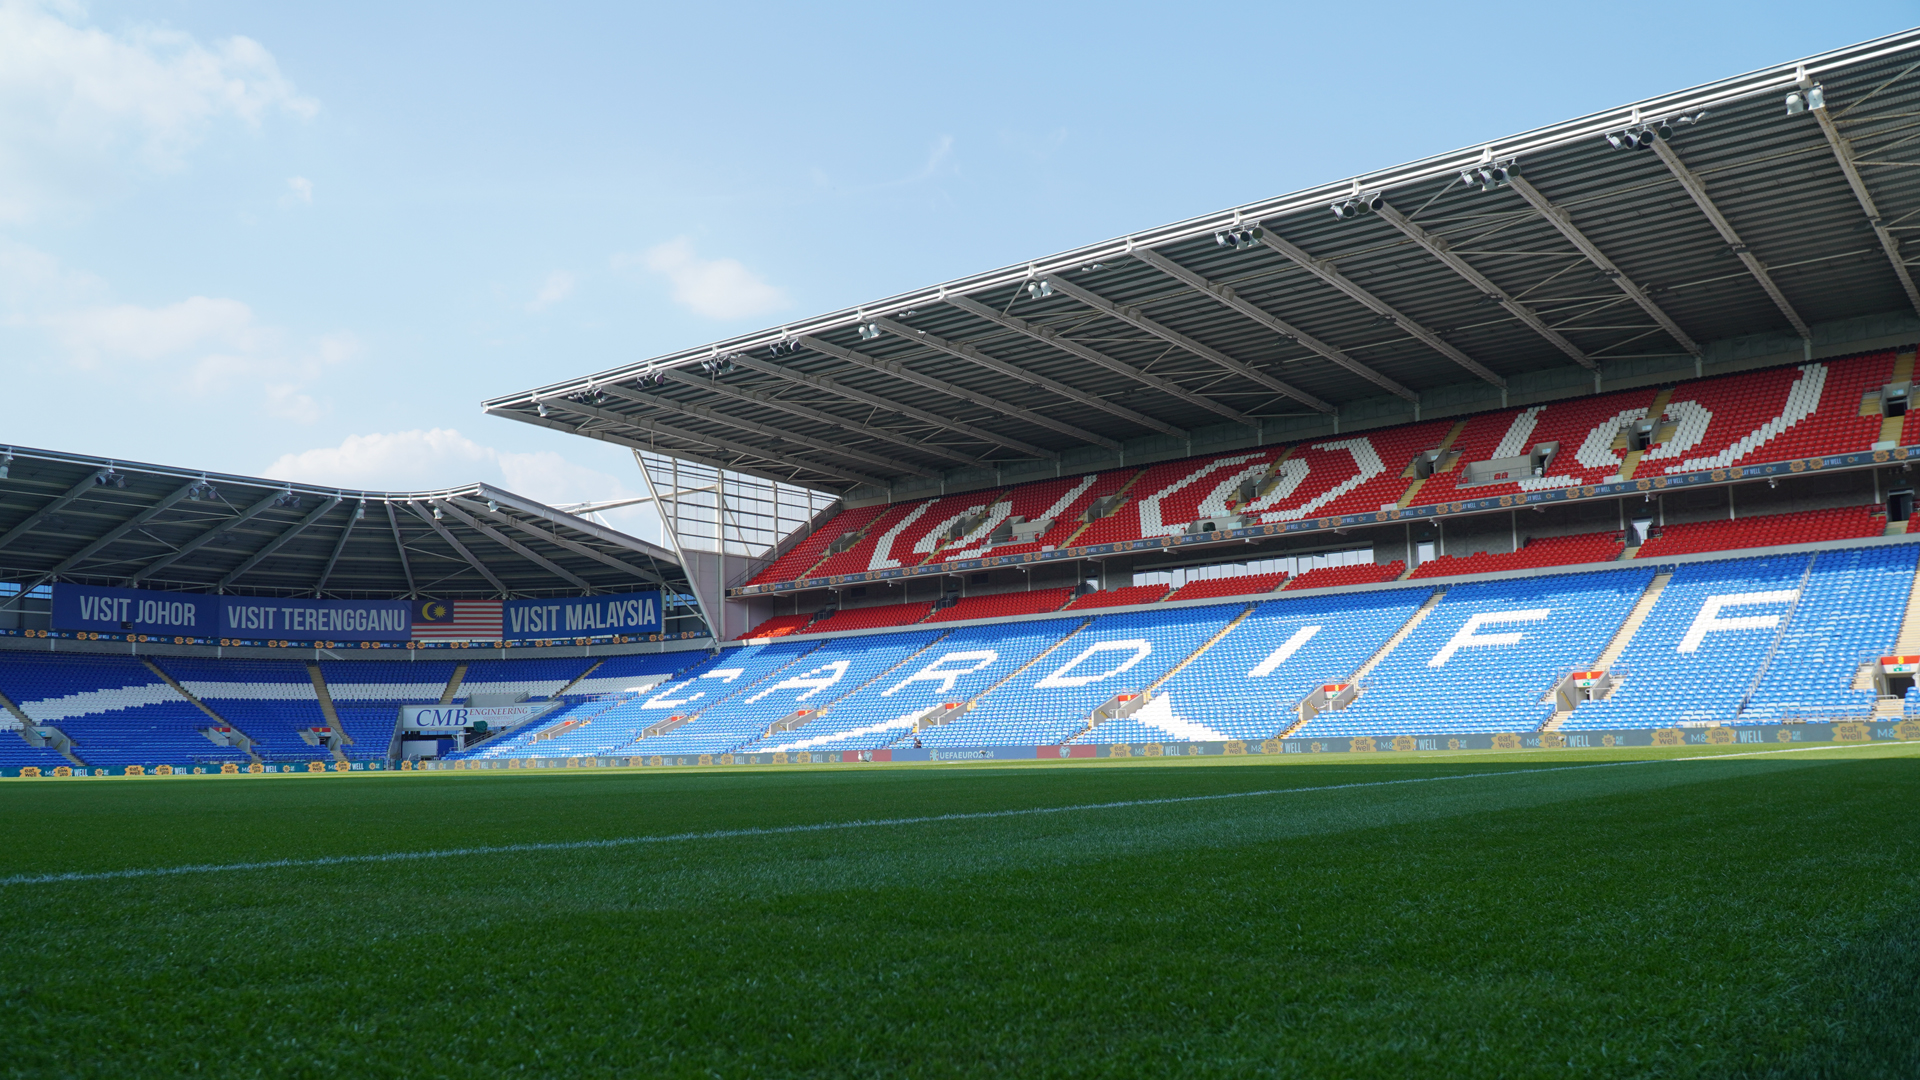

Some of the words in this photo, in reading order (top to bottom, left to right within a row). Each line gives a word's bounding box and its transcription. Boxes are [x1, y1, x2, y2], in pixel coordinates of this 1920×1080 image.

[80, 596, 131, 622] VISIT
[136, 600, 195, 626] JOHOR
[510, 606, 560, 632] VISIT
[566, 598, 656, 630] MALAYSIA
[228, 606, 277, 629] VISIT
[281, 608, 405, 631] TERENGGANU
[416, 709, 468, 726] CMB
[469, 707, 528, 716] ENGINEERING
[1840, 724, 1858, 733] eat
[1569, 735, 1590, 747] WELL
[1659, 734, 1677, 745] well
[1739, 730, 1764, 743] WELL
[1841, 731, 1862, 740] well
[1285, 742, 1302, 753] WELL
[1419, 739, 1437, 750] WELL
[1498, 740, 1514, 748] well
[1165, 746, 1180, 756] WELL
[813, 754, 823, 763] WELL
